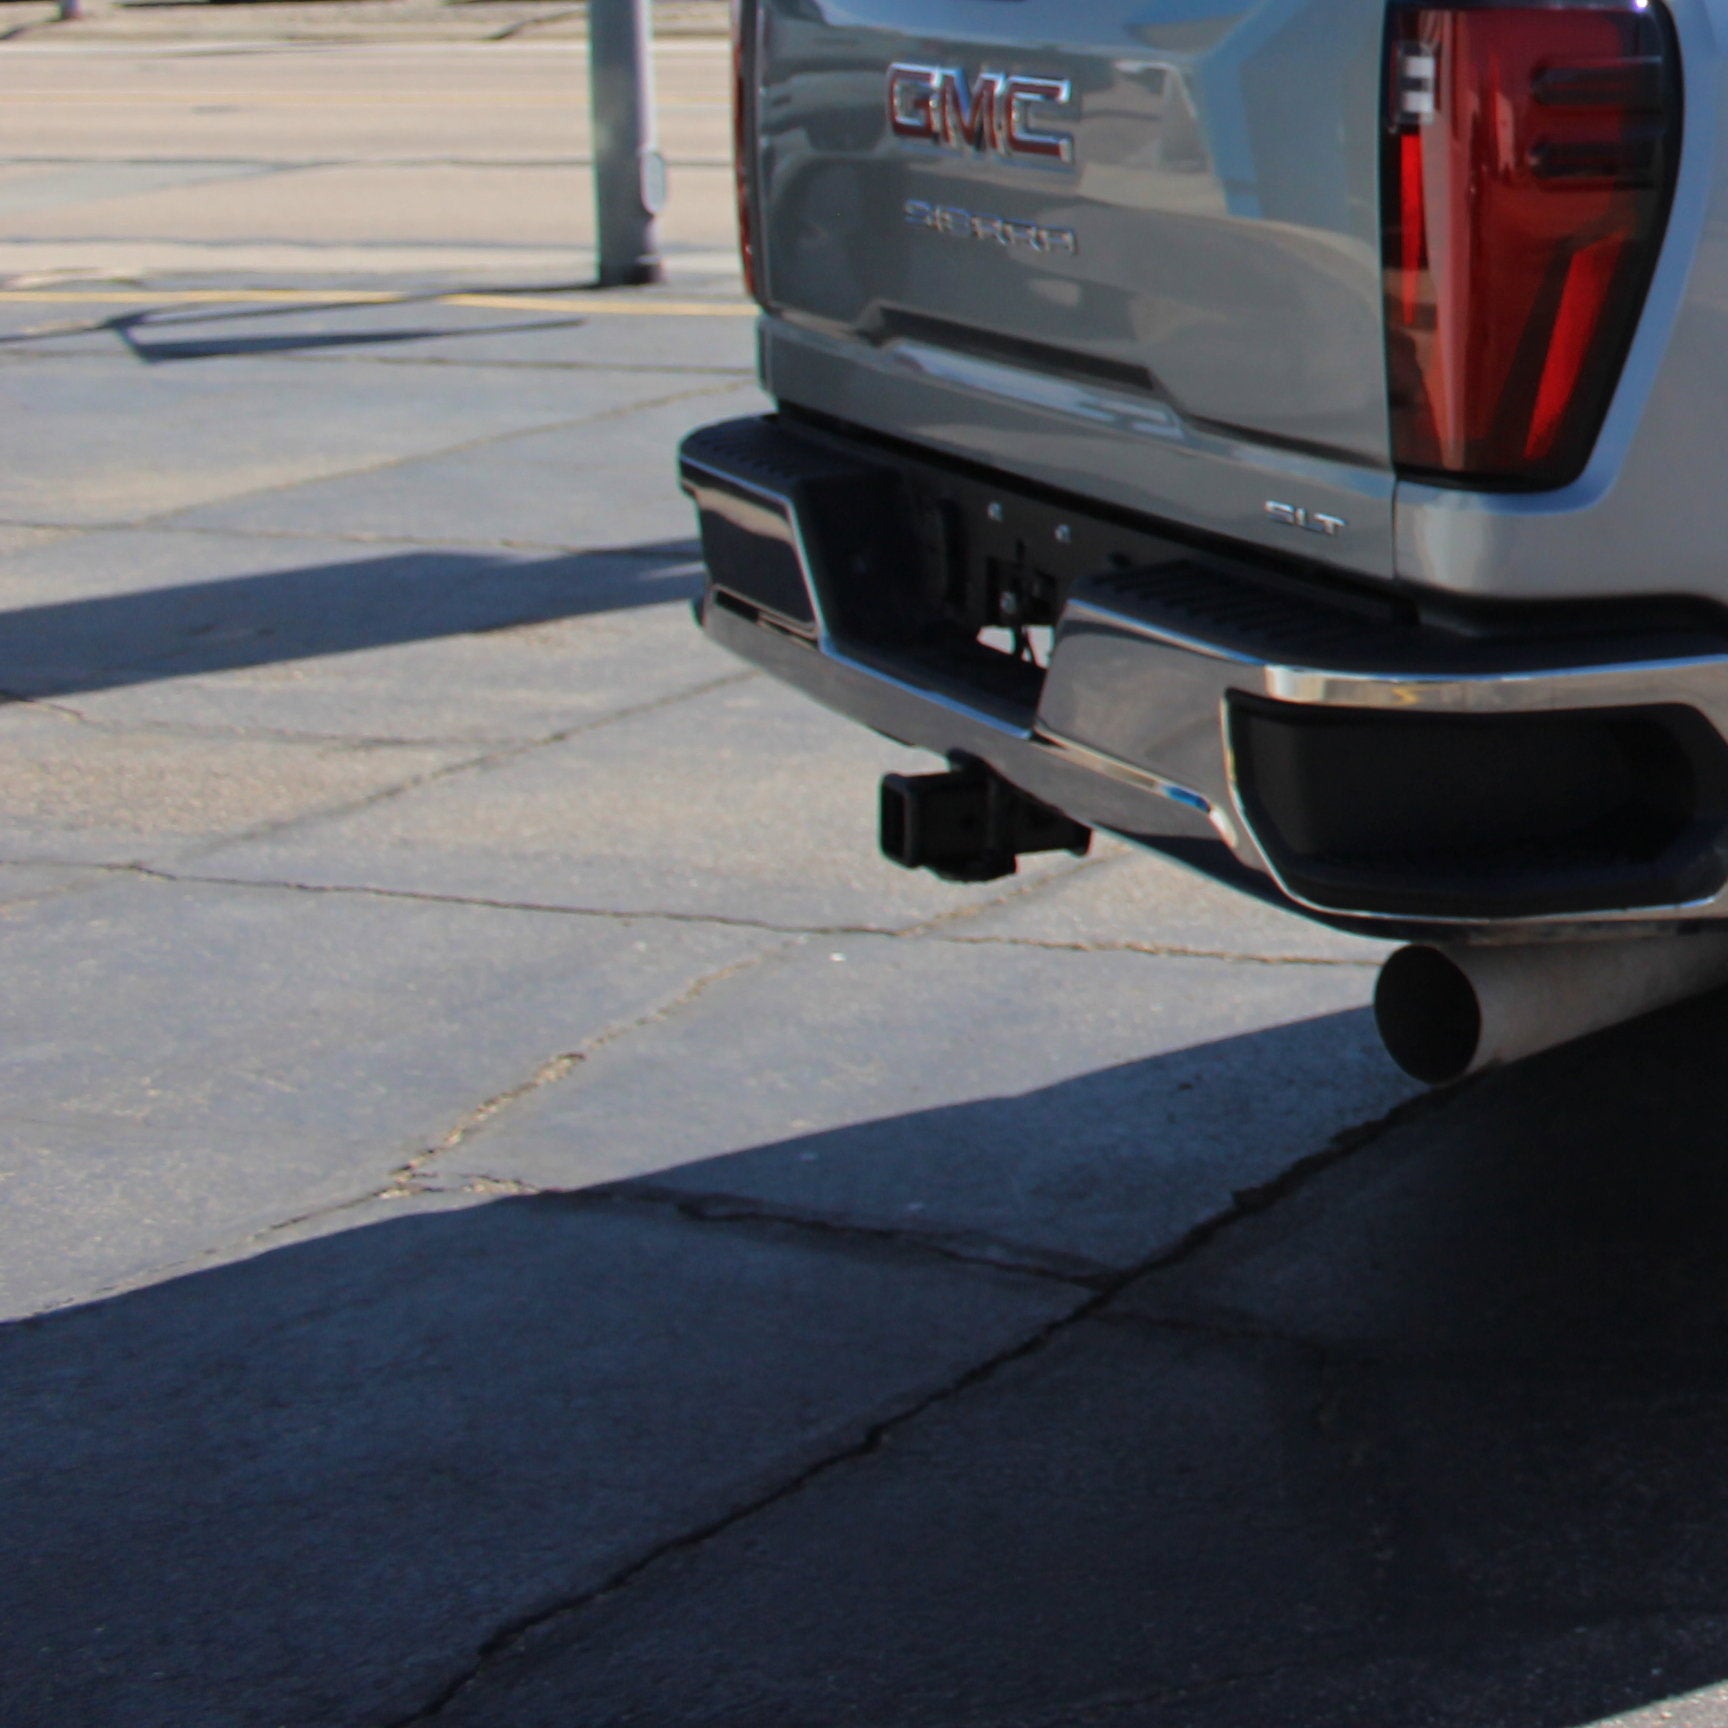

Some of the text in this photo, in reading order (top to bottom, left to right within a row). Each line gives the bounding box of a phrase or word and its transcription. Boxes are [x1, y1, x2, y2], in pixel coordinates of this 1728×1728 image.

[886, 62, 1073, 162] GMC
[904, 198, 1077, 254] SIERRA
[1264, 500, 1346, 536] SLT
